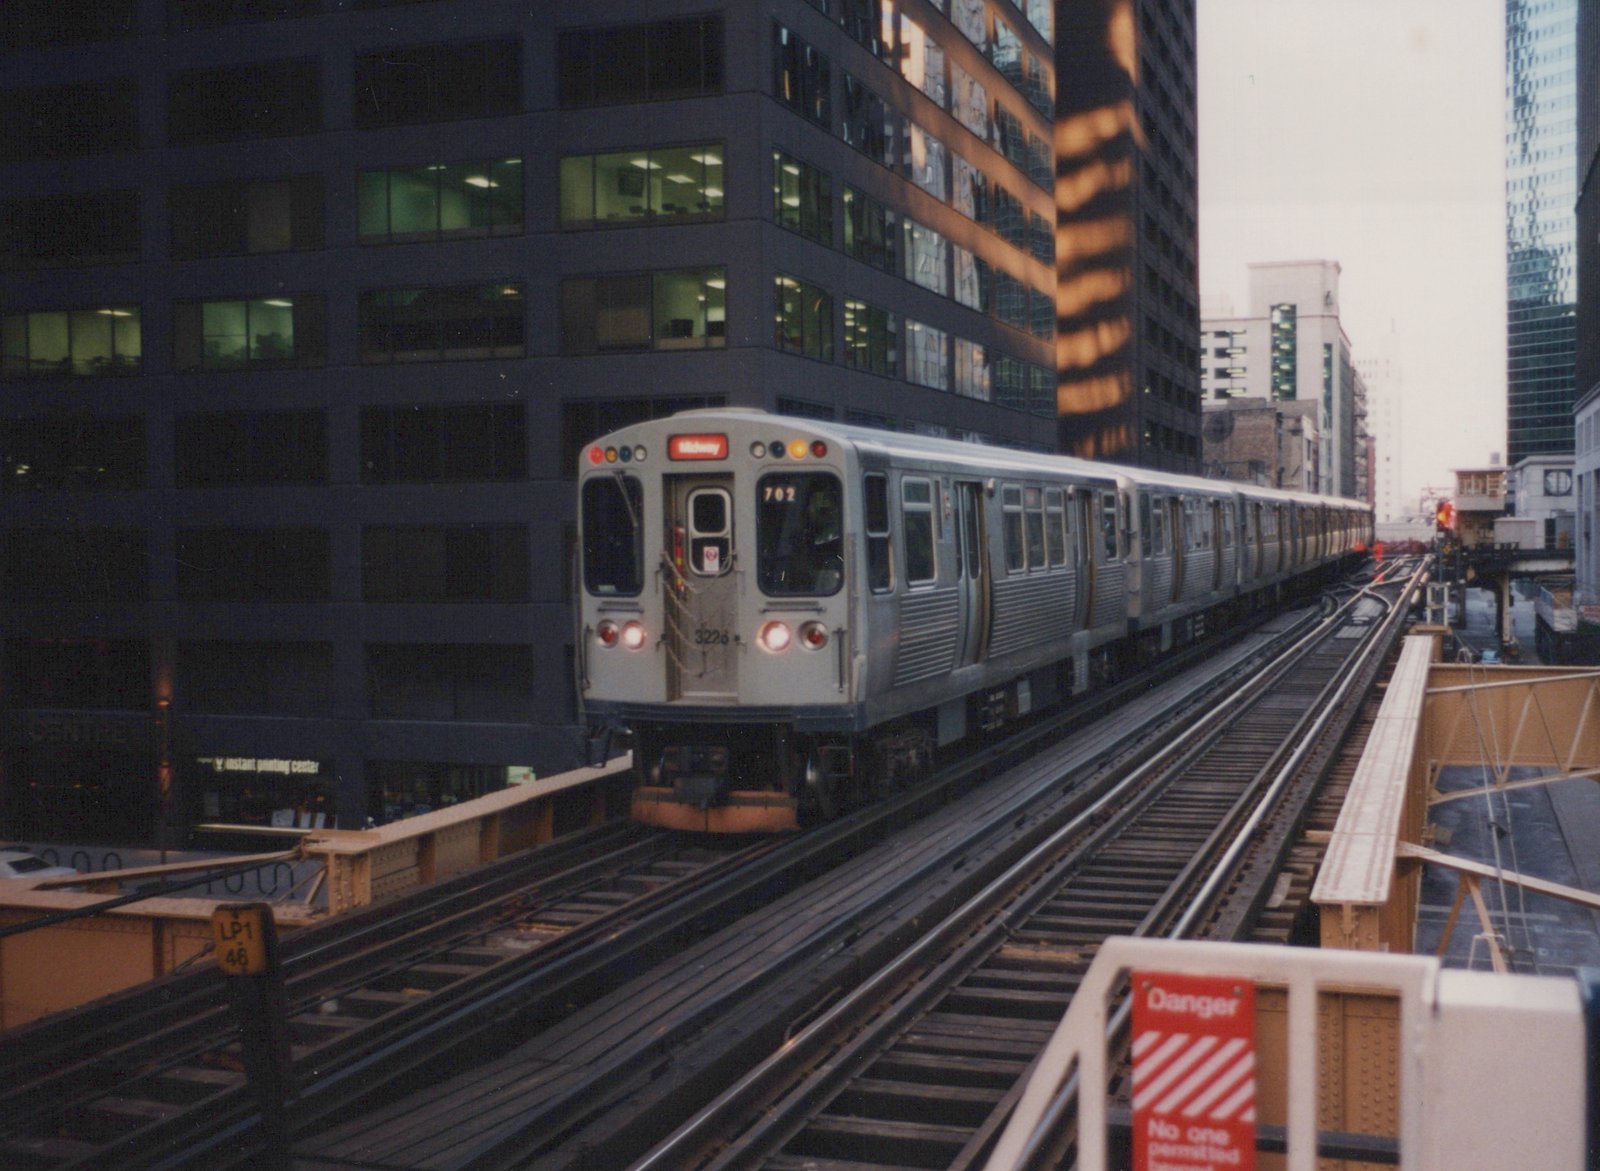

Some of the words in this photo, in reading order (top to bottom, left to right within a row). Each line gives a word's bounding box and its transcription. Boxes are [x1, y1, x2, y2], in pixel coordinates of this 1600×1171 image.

[764, 486, 795, 501] 702
[1147, 986, 1240, 1019] Danger
[1147, 1118, 1180, 1140] No
[1187, 1126, 1230, 1146] one
[1147, 1141, 1240, 1165] permitted
